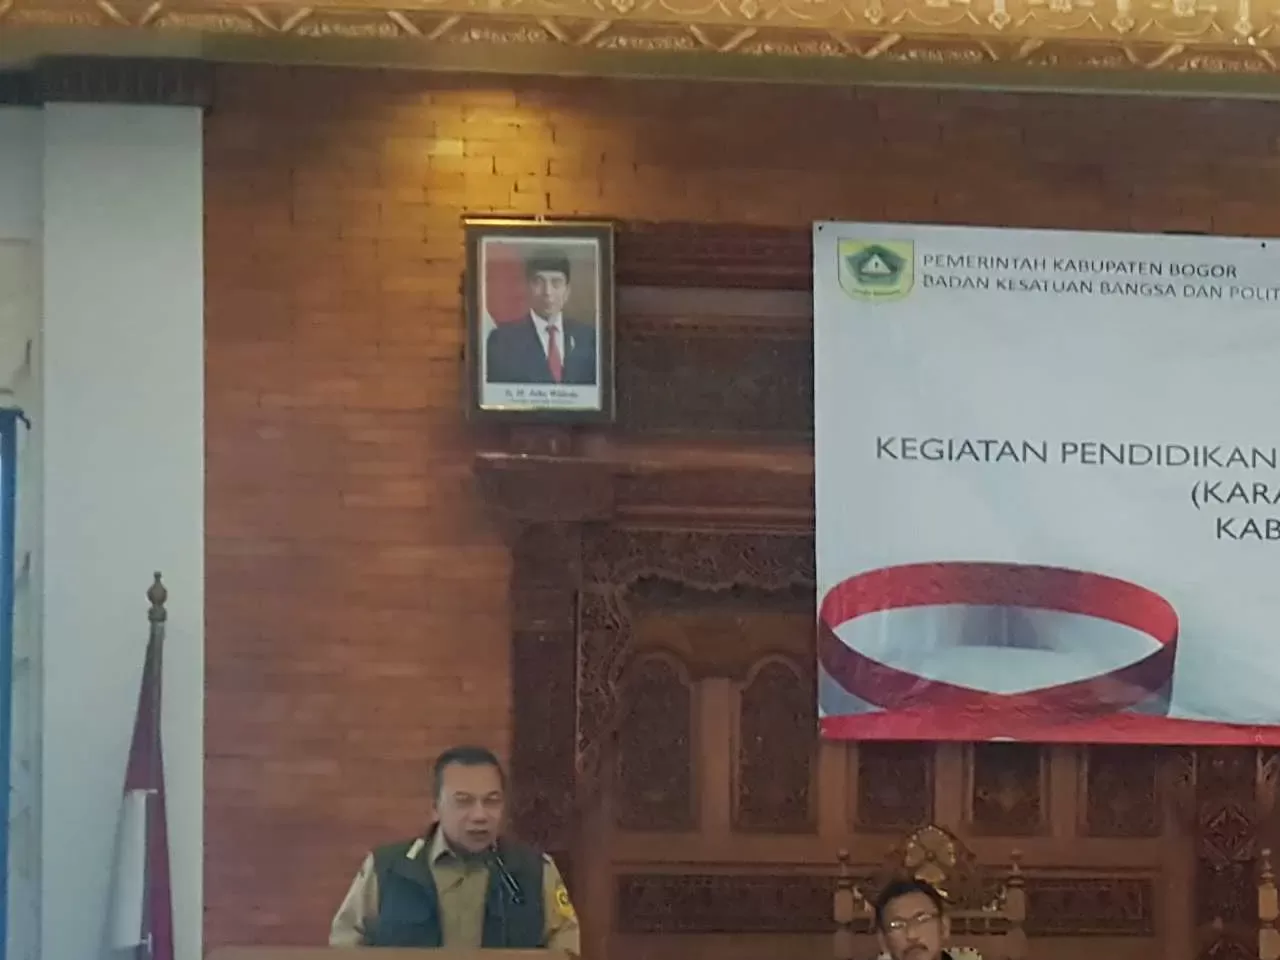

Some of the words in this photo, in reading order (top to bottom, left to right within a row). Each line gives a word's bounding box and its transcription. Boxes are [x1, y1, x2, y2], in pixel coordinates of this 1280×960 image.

[923, 254, 1046, 271] PEMERINTAH
[1053, 259, 1163, 276] KABUPATEN
[1169, 263, 1237, 278] BOGOR
[923, 273, 990, 290] BADAN
[996, 278, 1093, 294] KESATUAN
[1099, 281, 1177, 298] BANGSA
[1183, 284, 1222, 299] DAN
[876, 436, 1048, 463] KEGIATAN
[1061, 441, 1277, 469] PENDIDIKAN
